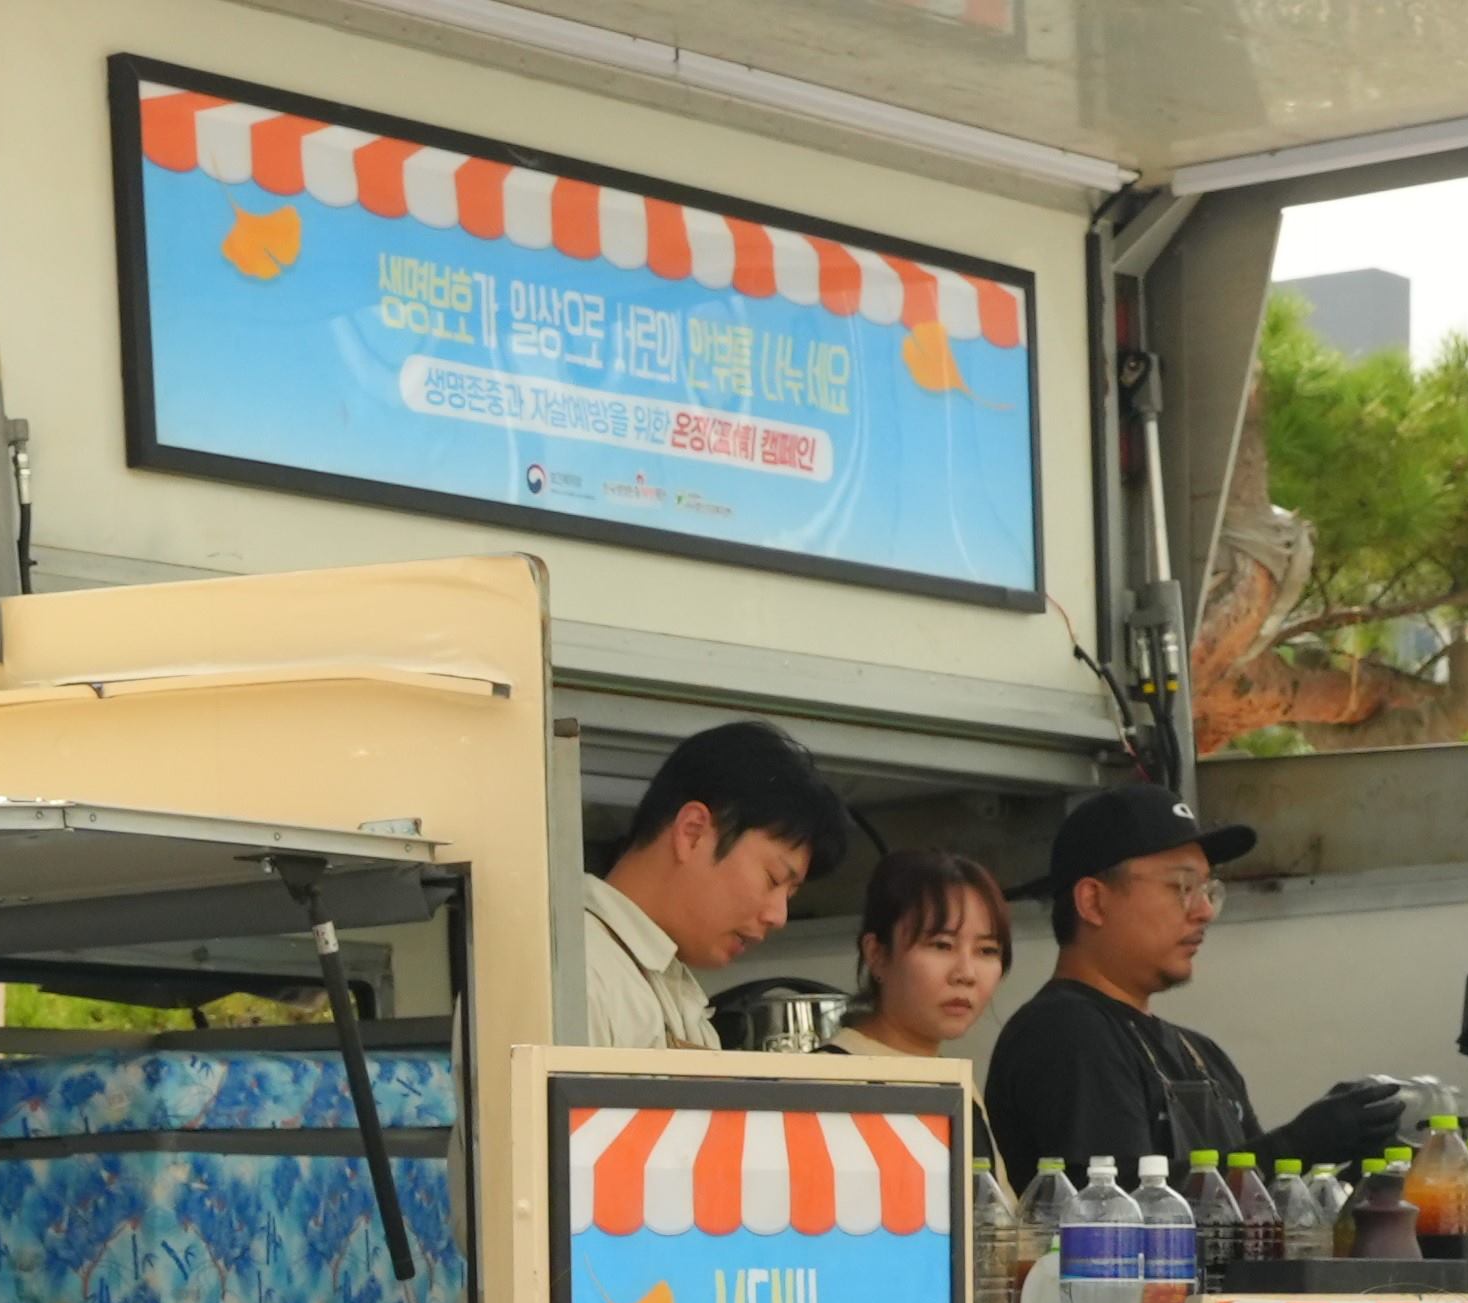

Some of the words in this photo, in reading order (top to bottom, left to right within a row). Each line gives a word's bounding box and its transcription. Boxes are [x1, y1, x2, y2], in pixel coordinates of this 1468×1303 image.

[424, 367, 525, 421] 생명존중과
[510, 280, 606, 370] 일상으로
[760, 331, 851, 417] 나누세요
